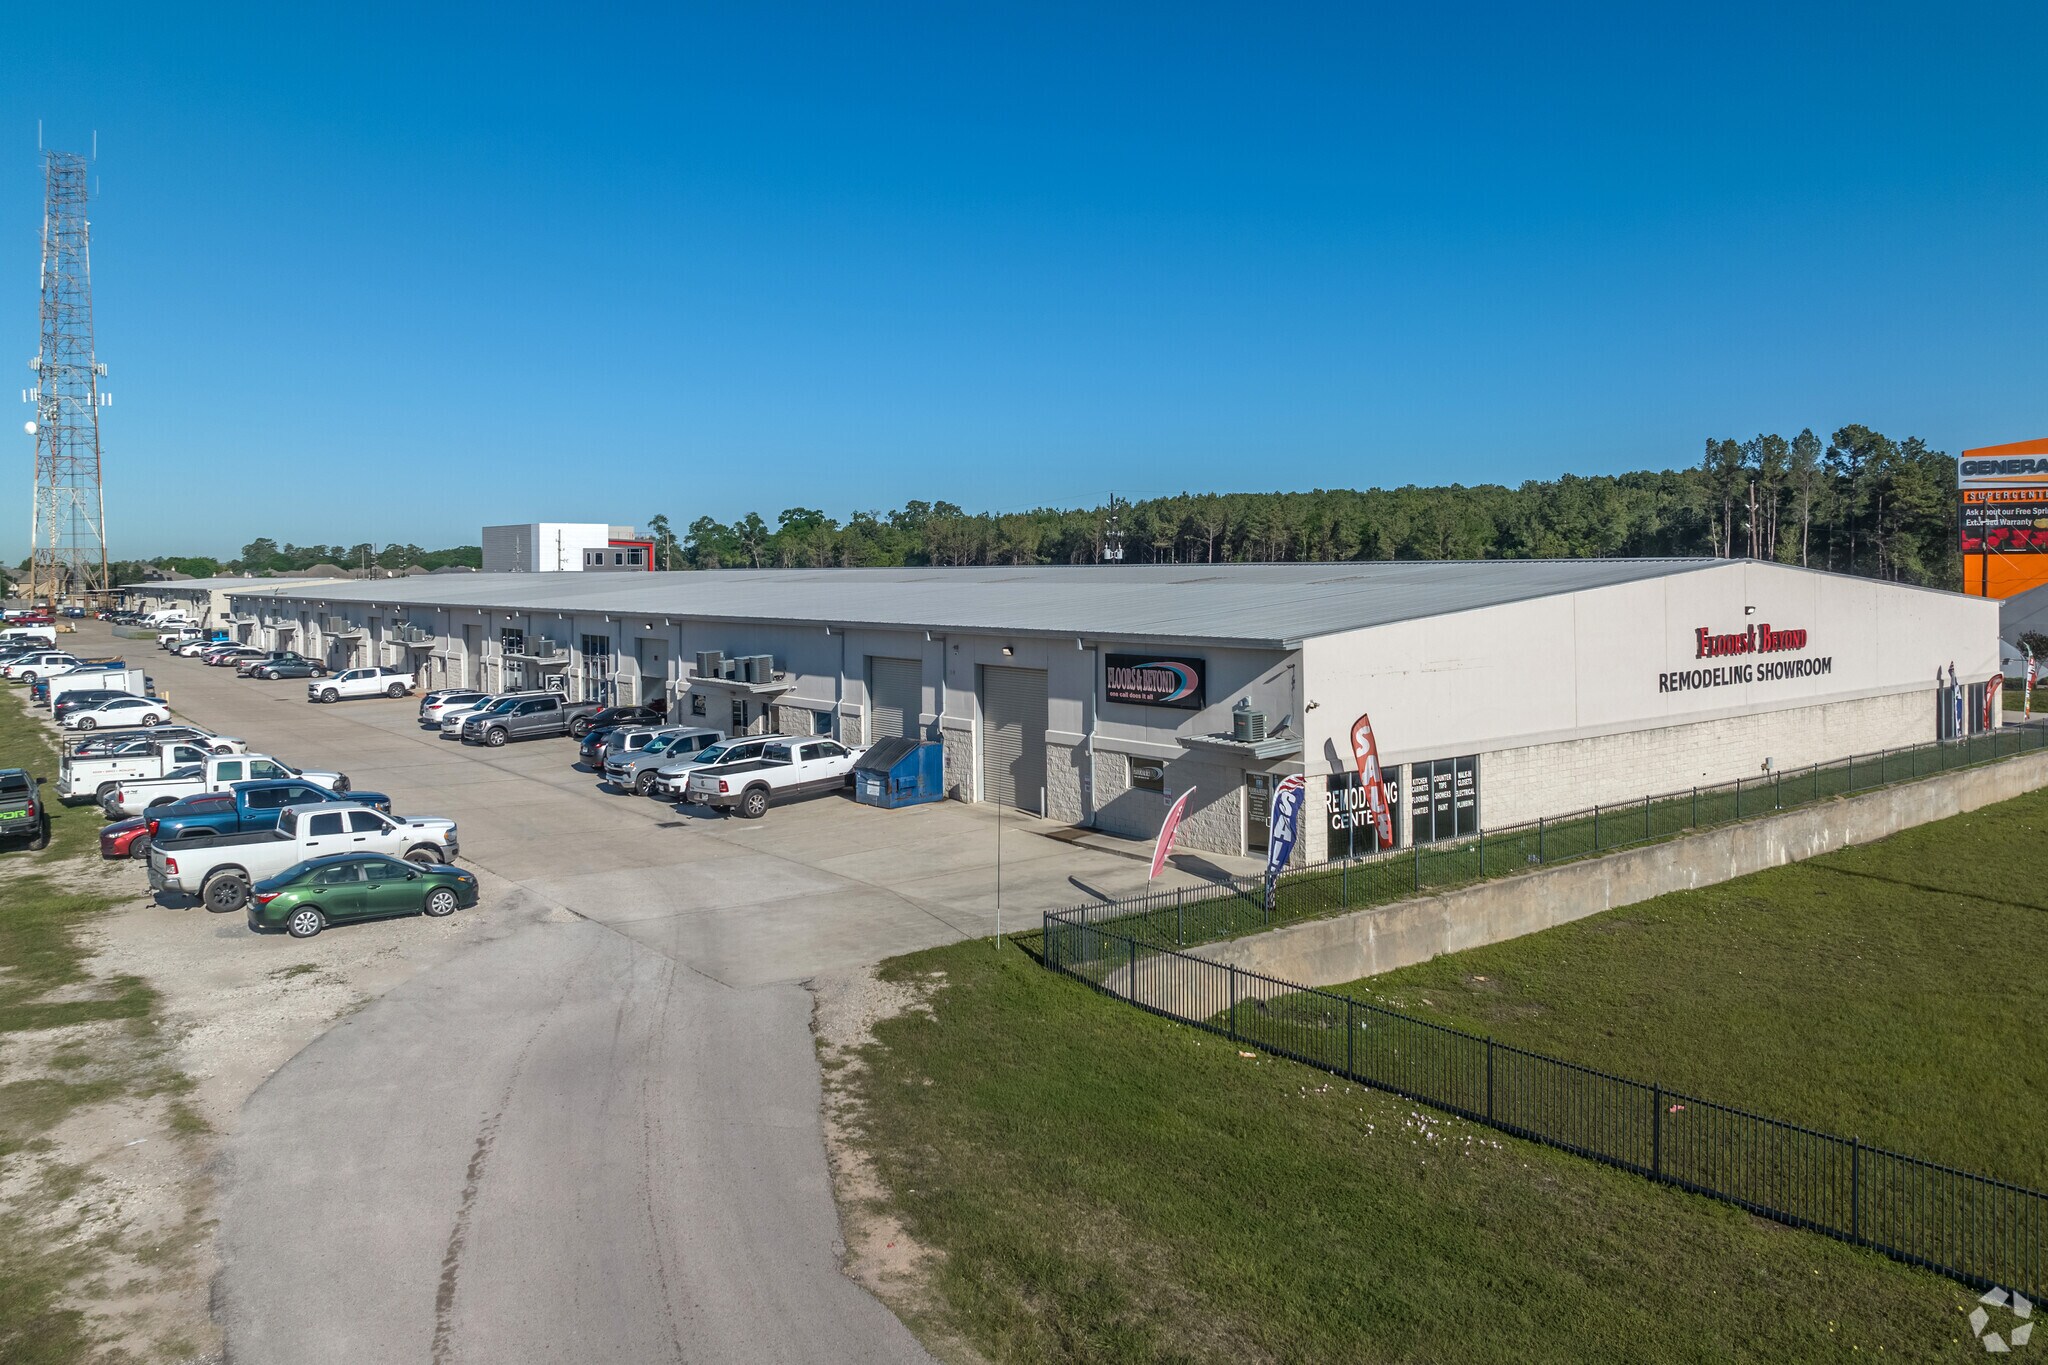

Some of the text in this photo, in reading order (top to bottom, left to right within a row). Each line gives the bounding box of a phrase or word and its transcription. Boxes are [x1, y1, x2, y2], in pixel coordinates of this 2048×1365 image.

[1965, 508, 1979, 516] Ask
[2015, 507, 2031, 515] Free
[2000, 518, 2032, 527] Warranty
[1107, 667, 1136, 690] FLOORS
[1143, 669, 1175, 693] BEYOND
[1659, 657, 1832, 693] REMODELING SHOWROOM
[1434, 773, 1451, 782] COUNTER
[1332, 810, 1375, 829] CENTE
